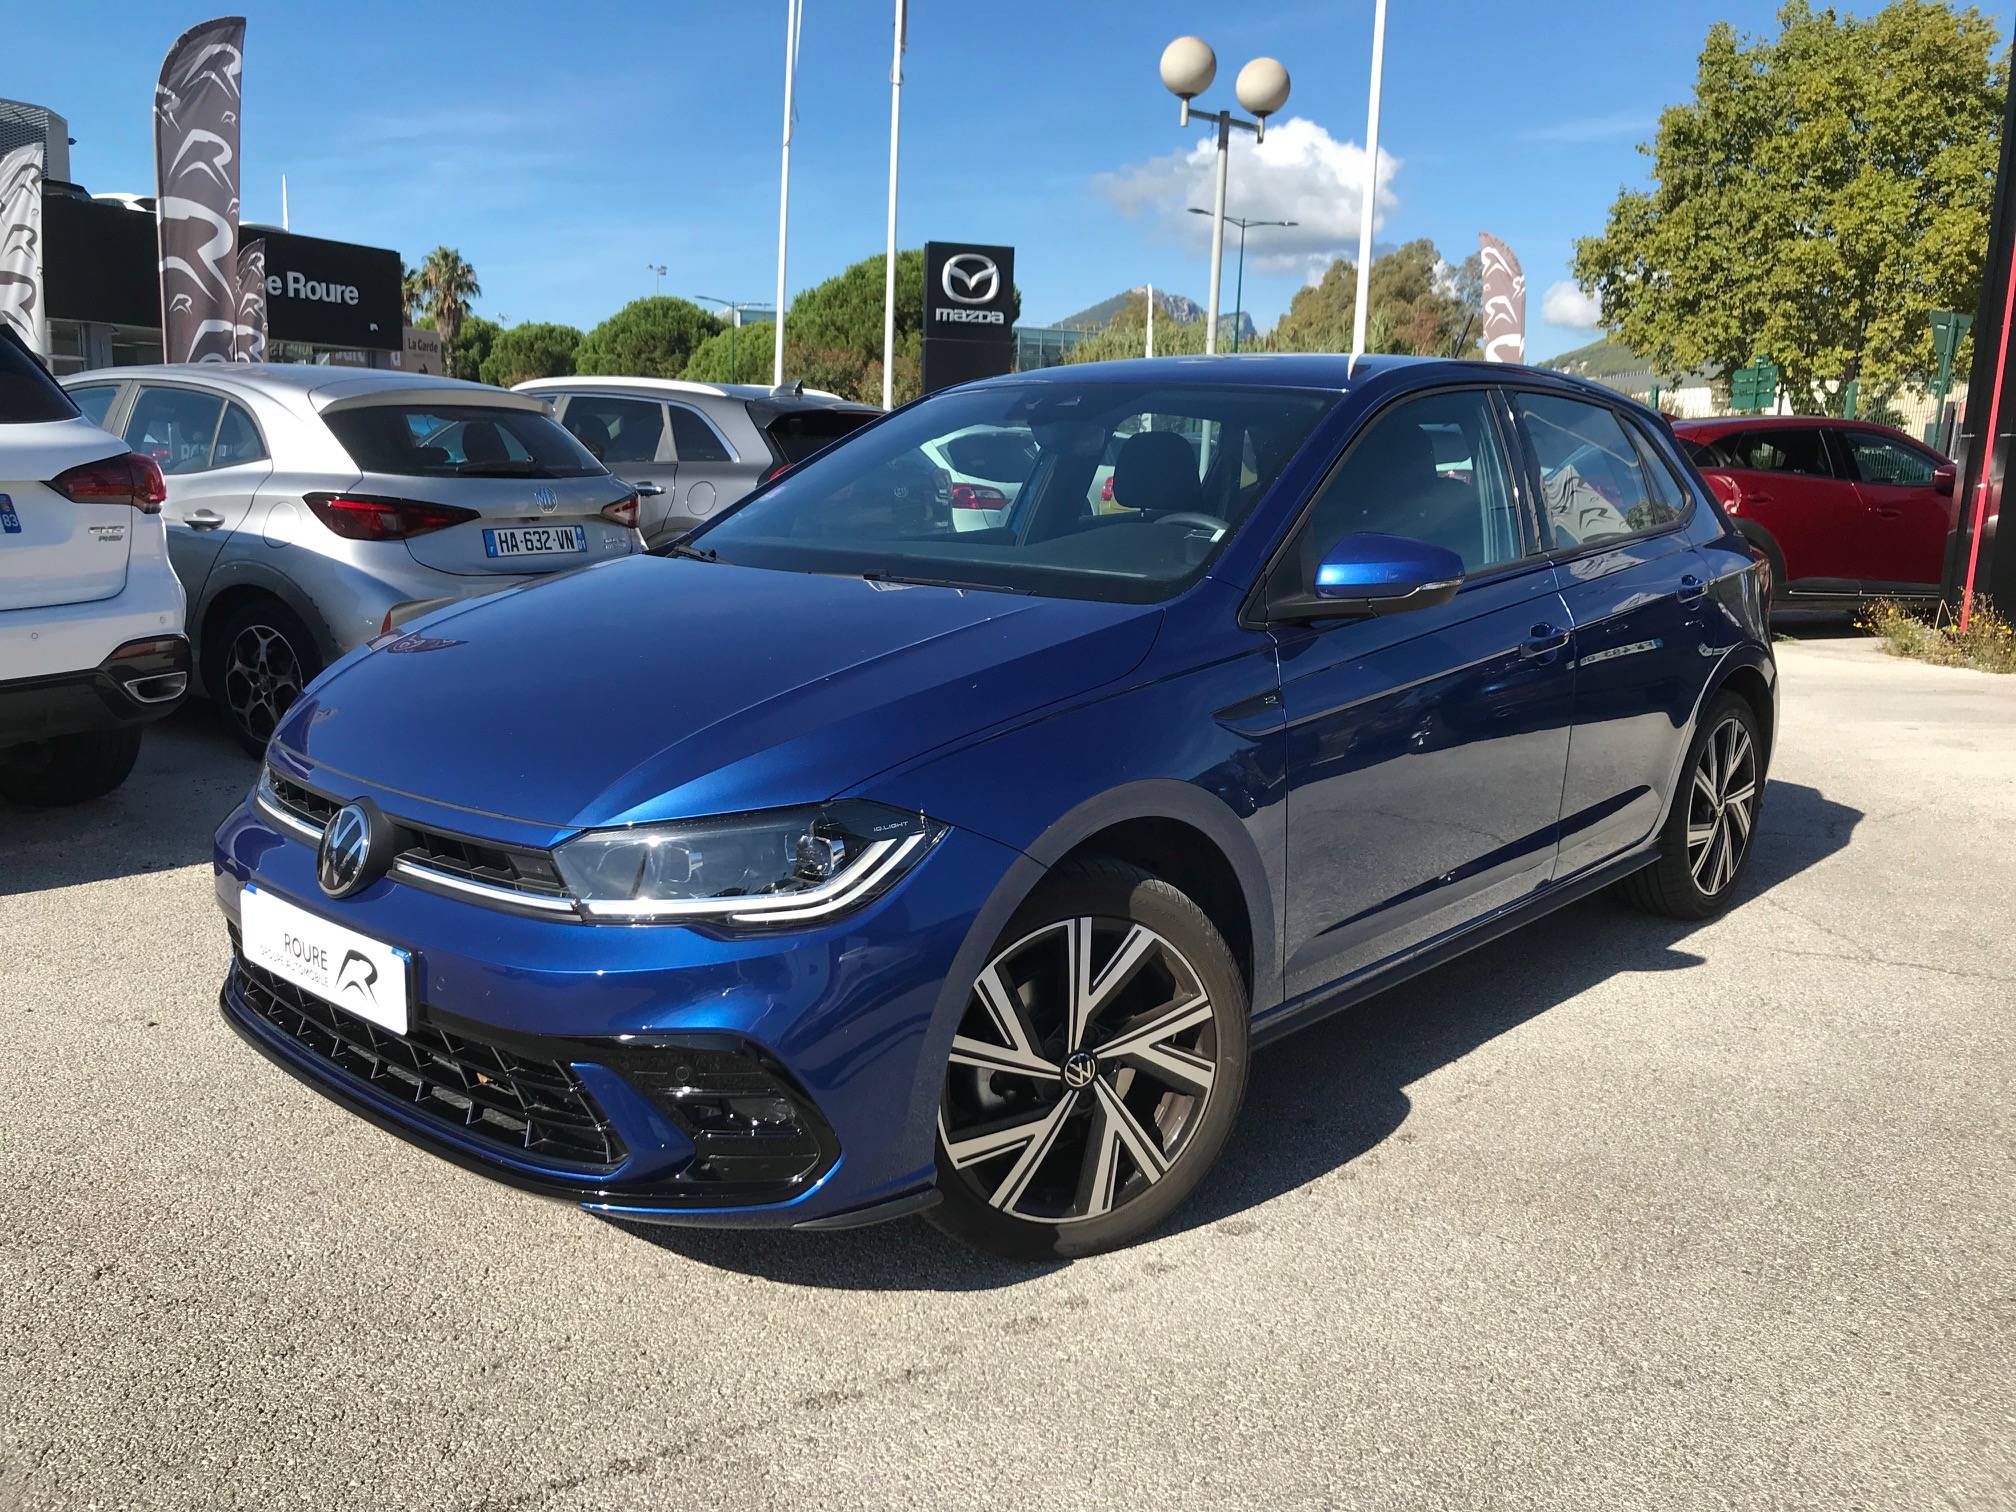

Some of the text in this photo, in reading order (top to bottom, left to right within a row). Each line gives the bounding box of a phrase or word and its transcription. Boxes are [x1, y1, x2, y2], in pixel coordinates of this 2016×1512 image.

[286, 271, 360, 306] Roure
[407, 338, 439, 353] La Garde
[2, 513, 19, 527] 83
[498, 529, 575, 553] HA-632-VN
[284, 932, 328, 971] ROURE
